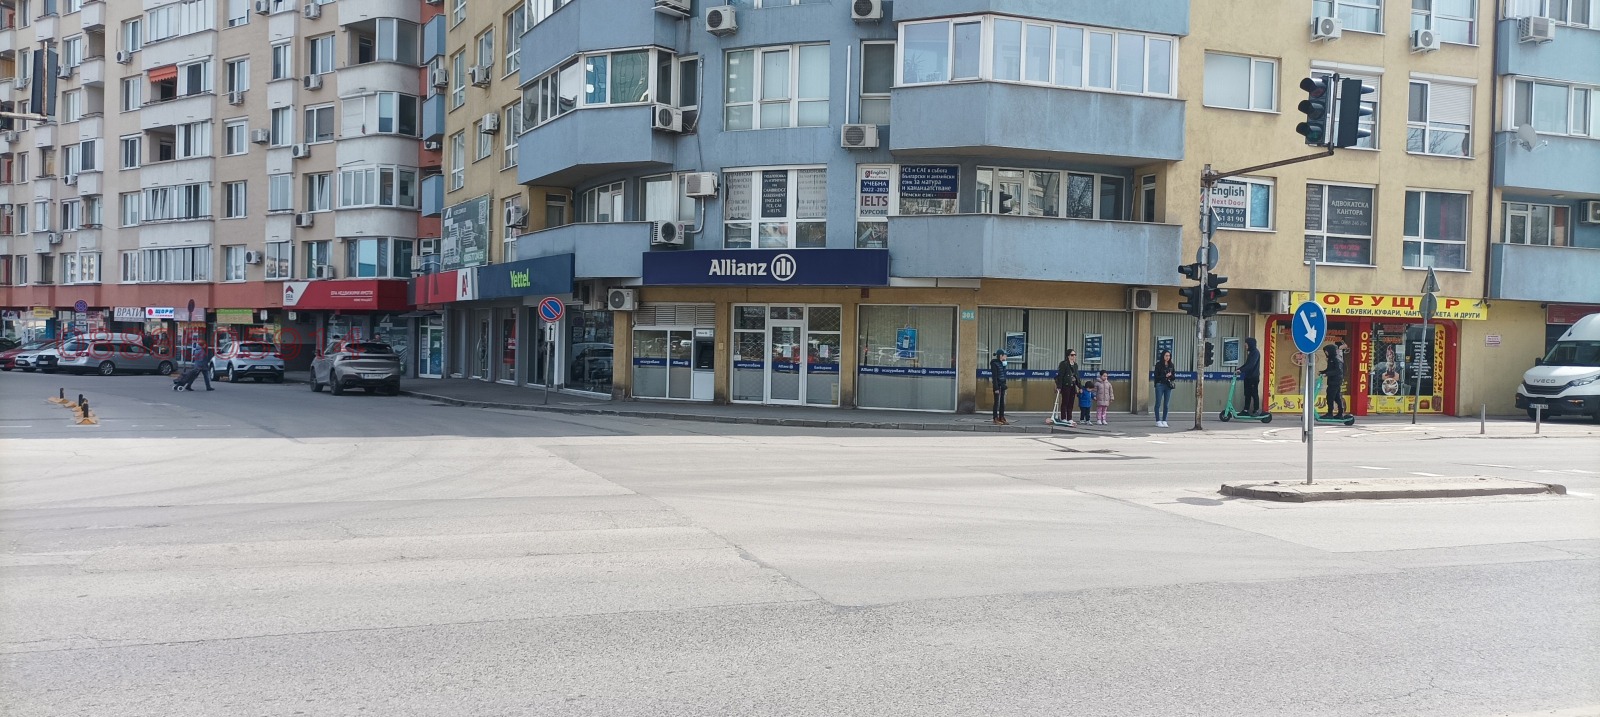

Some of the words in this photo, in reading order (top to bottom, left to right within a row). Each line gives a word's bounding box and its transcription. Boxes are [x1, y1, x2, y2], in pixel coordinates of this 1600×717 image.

[1212, 186, 1244, 198] English
[861, 196, 888, 206] IELTS
[708, 259, 767, 276] Allianz
[1323, 294, 1460, 310] ОБУЩР
[116, 308, 141, 316] ВРАТИ
[1359, 332, 1368, 392] ОБУЩАР
